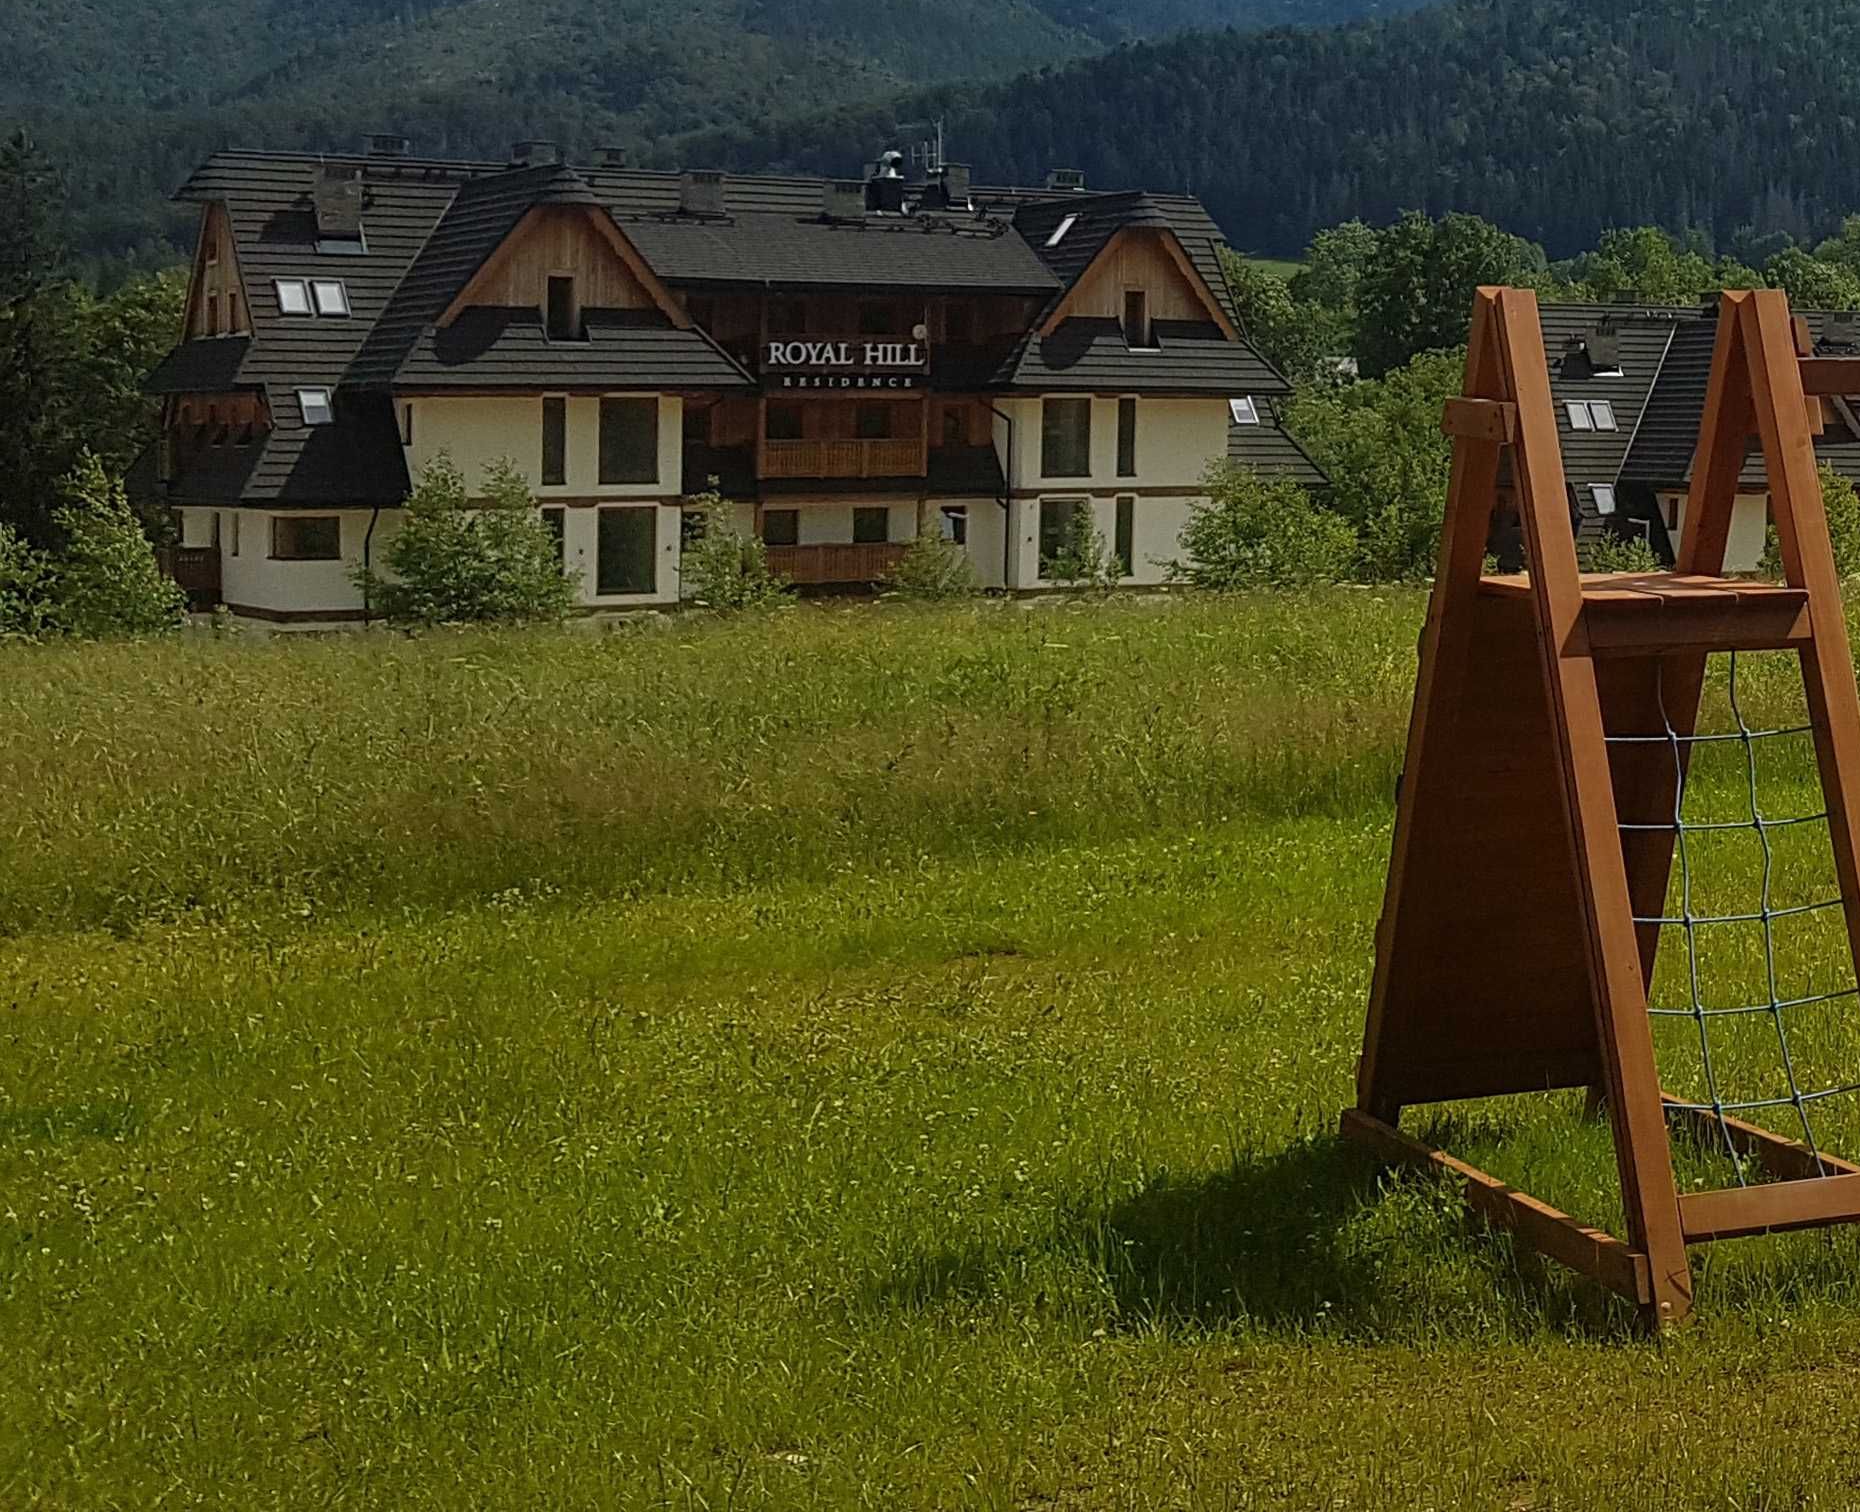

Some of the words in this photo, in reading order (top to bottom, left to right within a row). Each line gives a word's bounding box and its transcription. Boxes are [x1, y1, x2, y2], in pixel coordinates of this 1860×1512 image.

[768, 342, 854, 365] ROYAL
[863, 343, 925, 366] HILL
[783, 376, 912, 387] RESIDENCE
